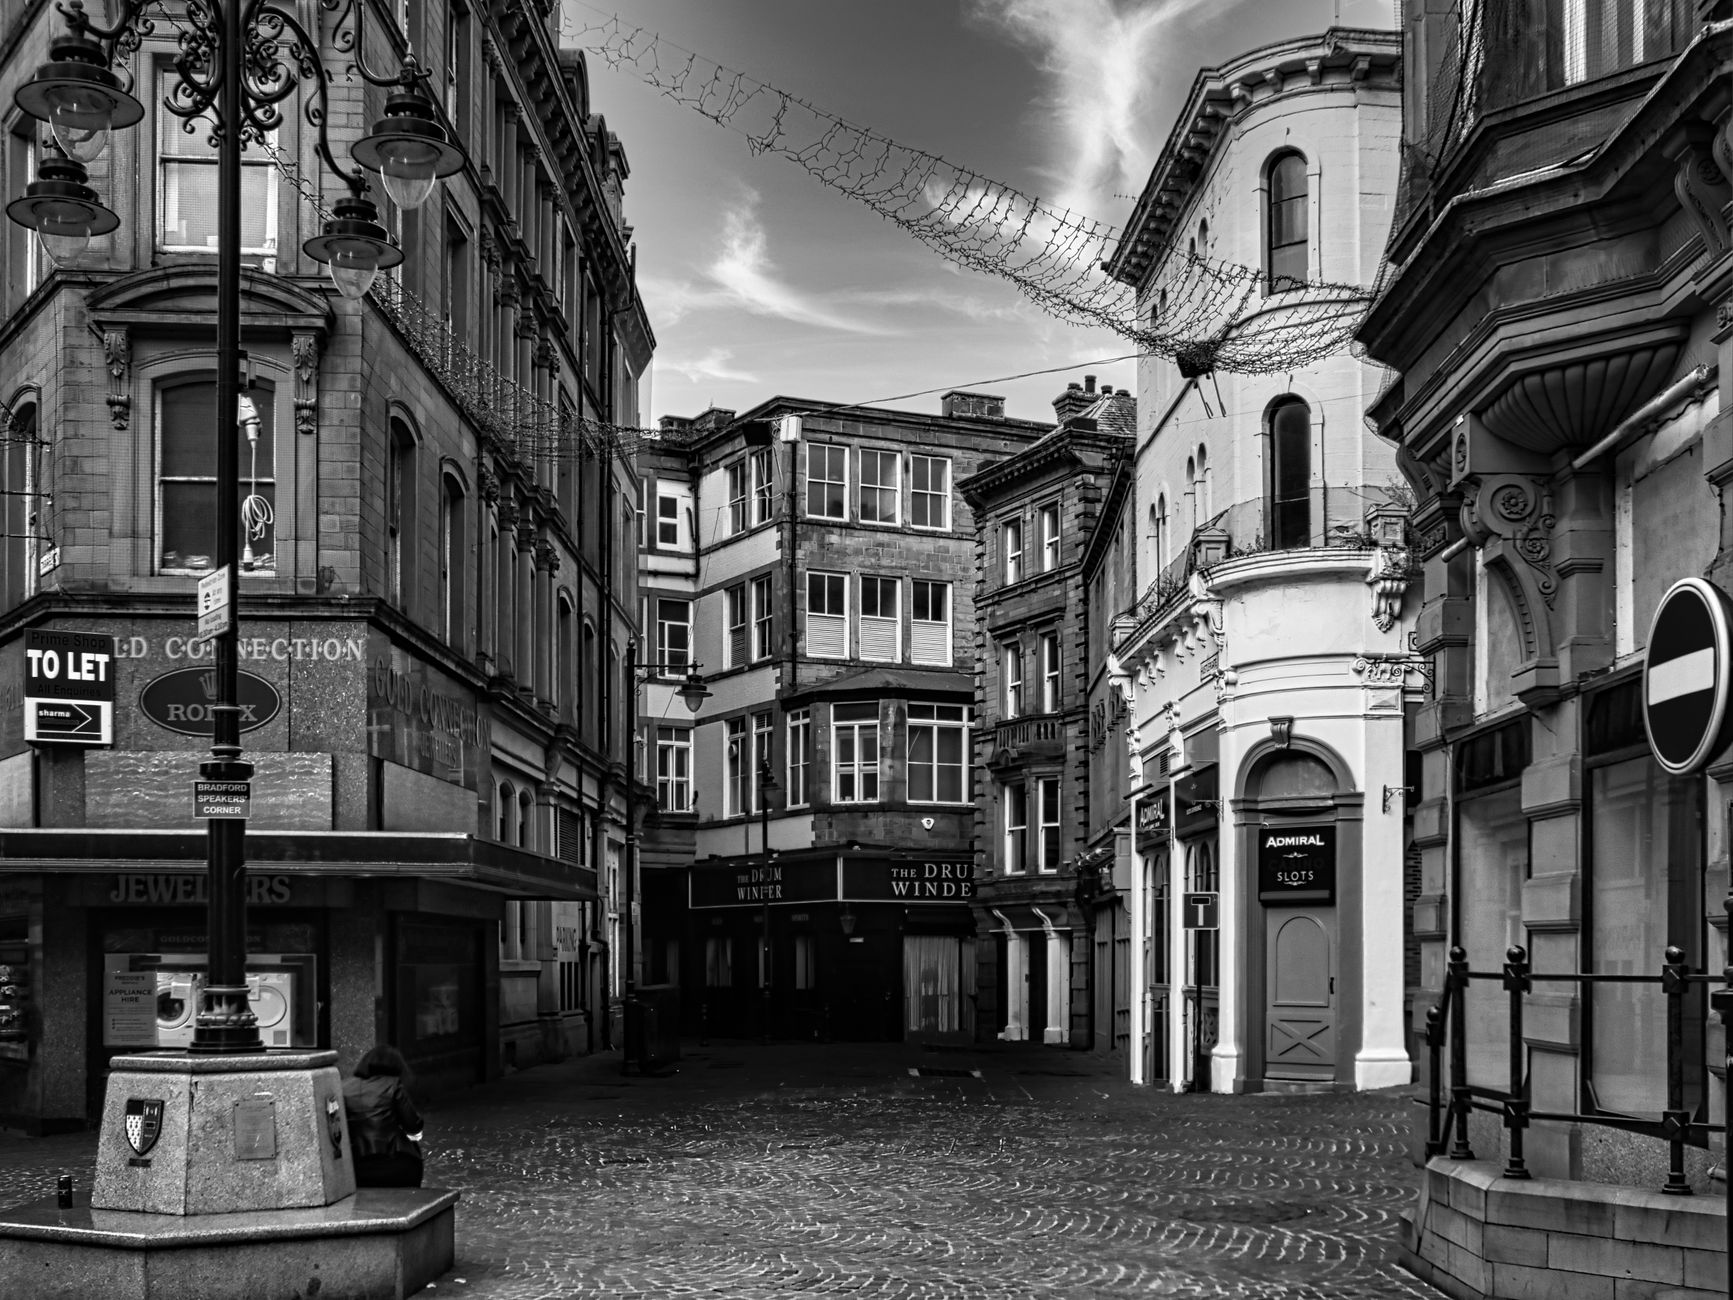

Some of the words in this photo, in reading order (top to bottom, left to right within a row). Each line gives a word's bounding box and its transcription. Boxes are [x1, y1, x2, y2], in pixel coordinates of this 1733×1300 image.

[31, 631, 70, 647] Prime
[74, 634, 106, 652] Shop
[26, 649, 60, 680] TO
[67, 651, 110, 682] LET
[38, 684, 50, 695] All
[54, 685, 102, 698] Enquiries
[375, 656, 412, 716] GOLD
[38, 708, 72, 719] sharma
[166, 703, 258, 722] ROLX
[197, 783, 248, 792] BRADFORD
[203, 806, 241, 814] CORNER
[1139, 798, 1166, 828] ADMIRAL
[1265, 834, 1326, 848] ADMIRAL
[891, 868, 917, 878] THE
[924, 863, 975, 879] DRU
[1276, 870, 1314, 882] SLOTS
